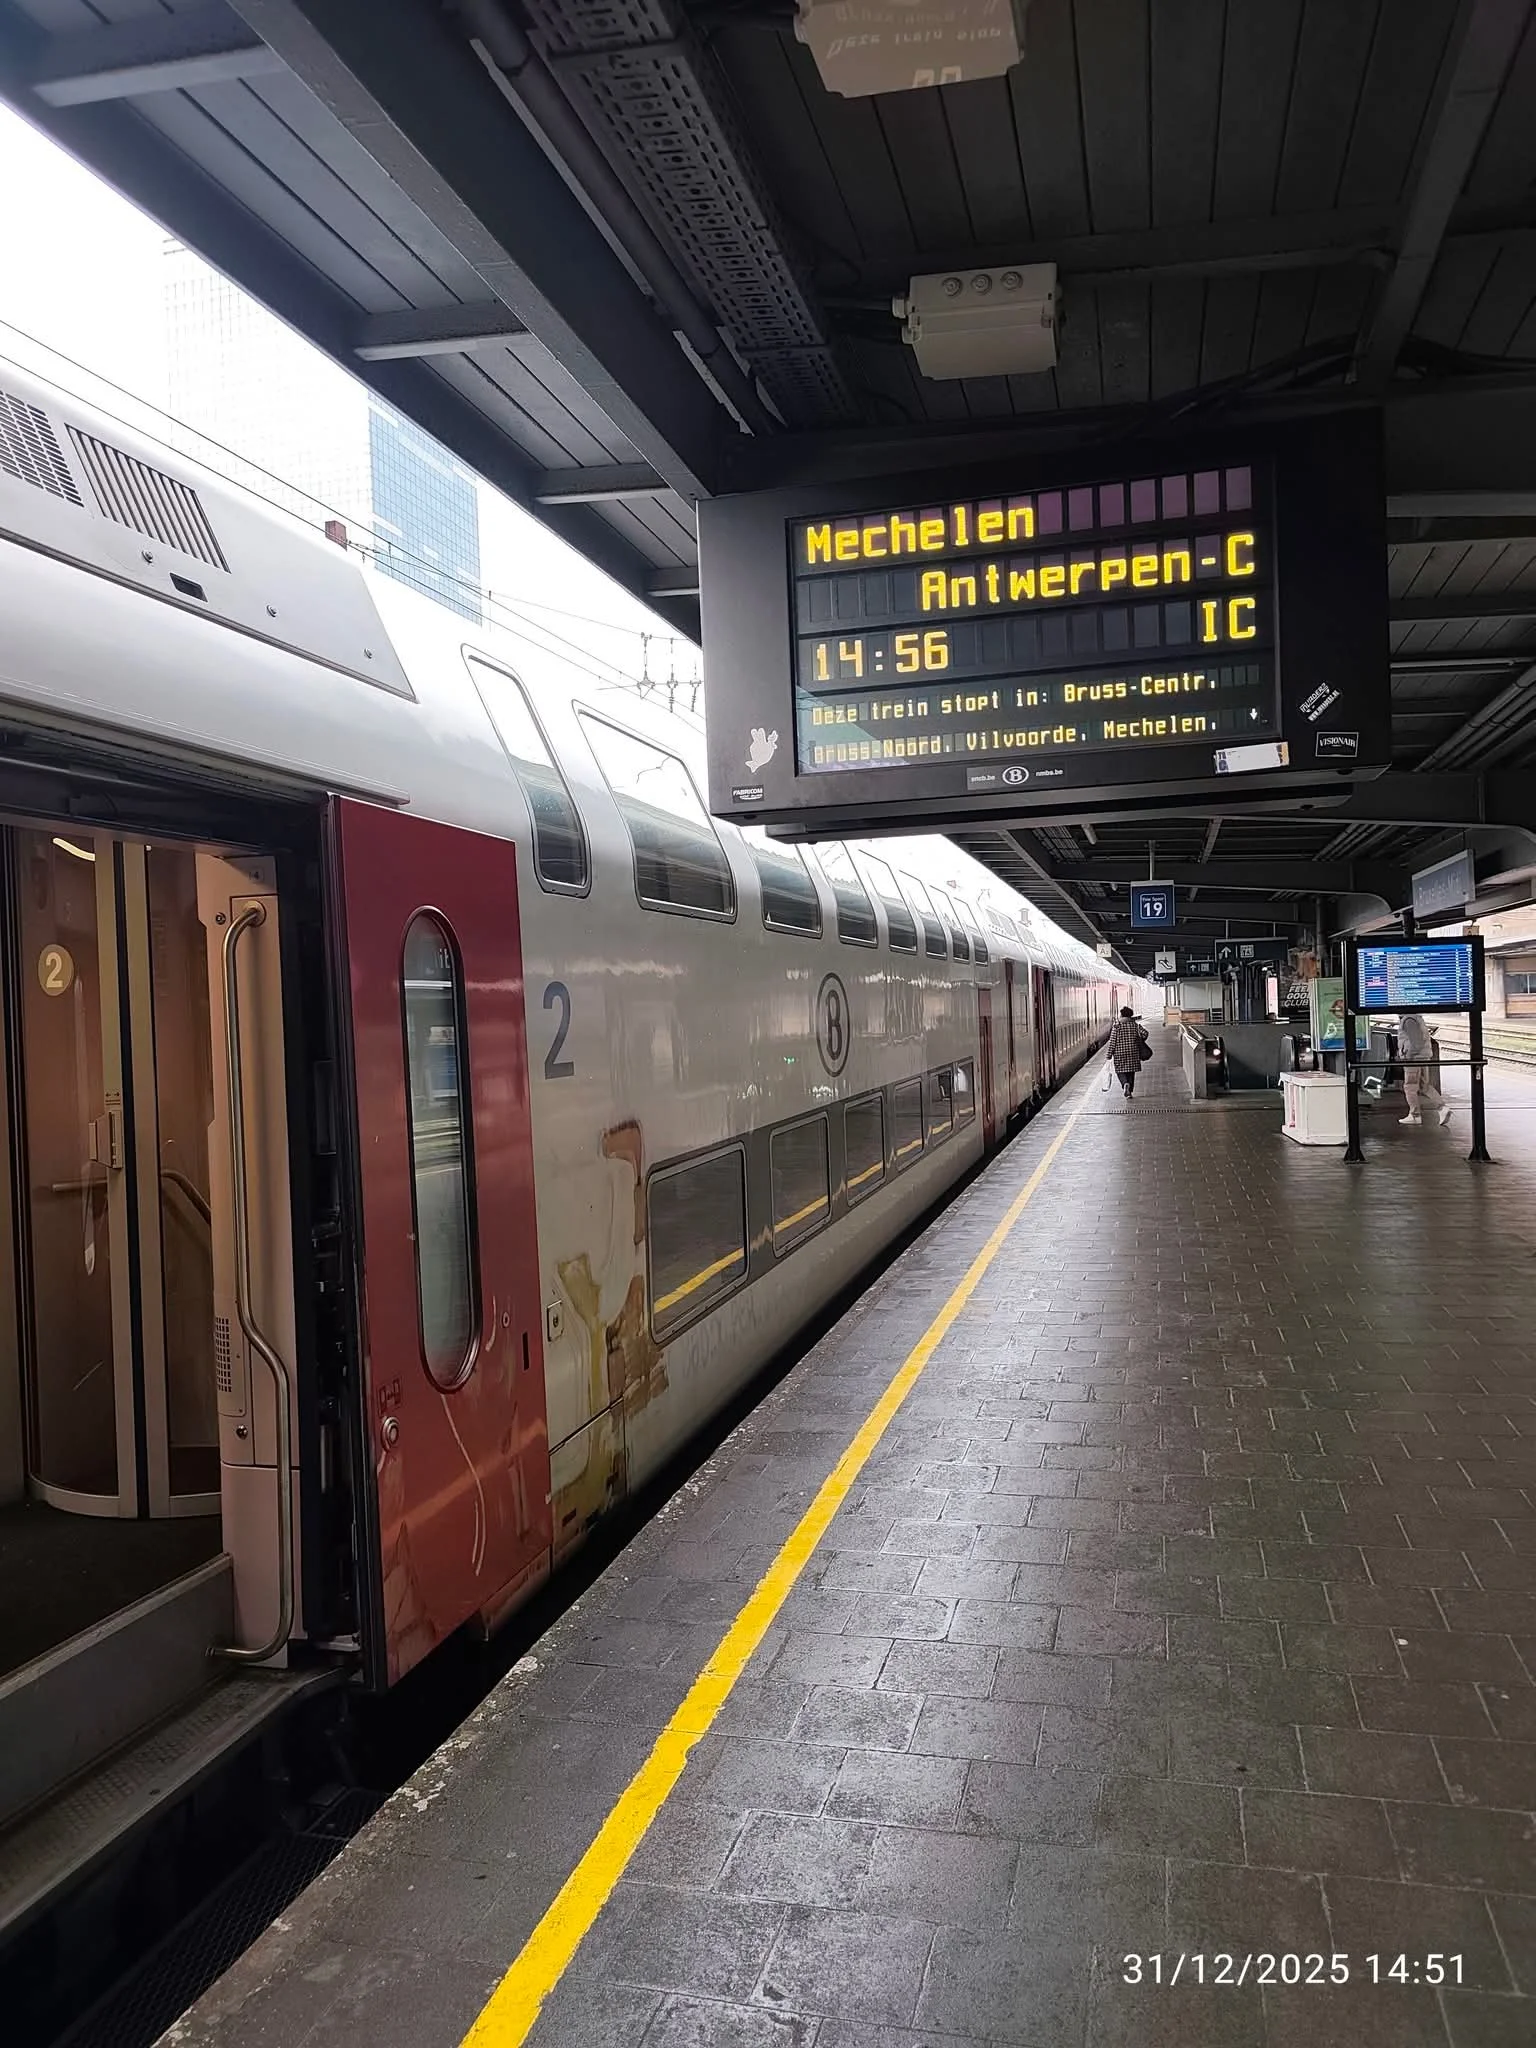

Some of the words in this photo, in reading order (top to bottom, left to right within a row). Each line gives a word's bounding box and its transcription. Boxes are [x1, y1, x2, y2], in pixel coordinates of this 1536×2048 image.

[807, 506, 1034, 564] Mechelen
[921, 533, 1255, 611] Antwerpen-C
[816, 631, 949, 681] 14:56
[1202, 597, 1256, 642] IC
[812, 707, 857, 726] Deze
[872, 699, 929, 720] trein
[941, 691, 999, 715] stopt
[1016, 688, 1047, 707] in:
[1319, 737, 1356, 747] VISIONAIR
[1035, 768, 1064, 777] nmbs.be
[1143, 901, 1163, 917] 19
[45, 951, 64, 988] 2
[1284, 999, 1309, 1008] CLUB
[543, 981, 575, 1080] 2
